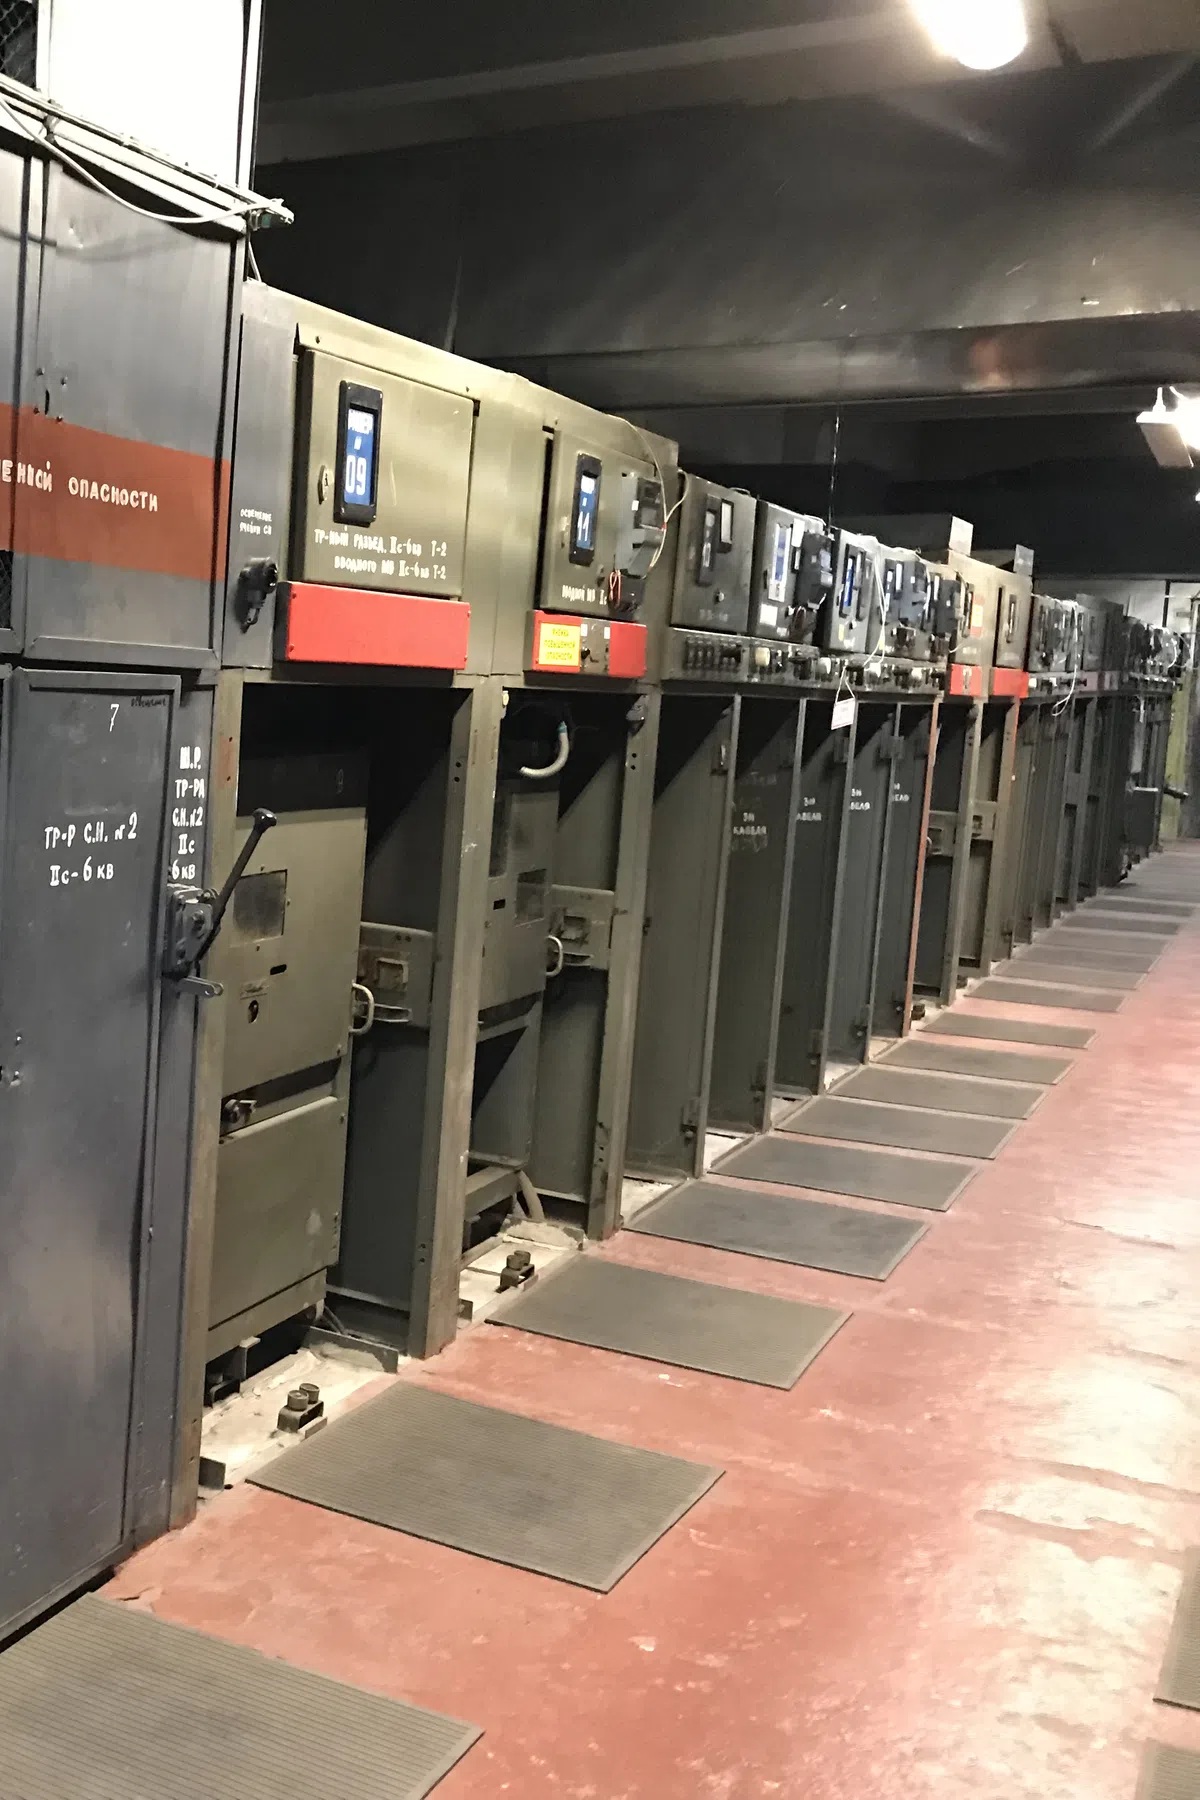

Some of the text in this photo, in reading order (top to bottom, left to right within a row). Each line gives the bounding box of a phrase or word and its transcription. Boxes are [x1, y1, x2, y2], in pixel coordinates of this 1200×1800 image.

[345, 454, 367, 496] 09
[68, 476, 158, 512] ОПАСНОСТИ
[577, 511, 590, 542] 11
[109, 703, 120, 732] 7
